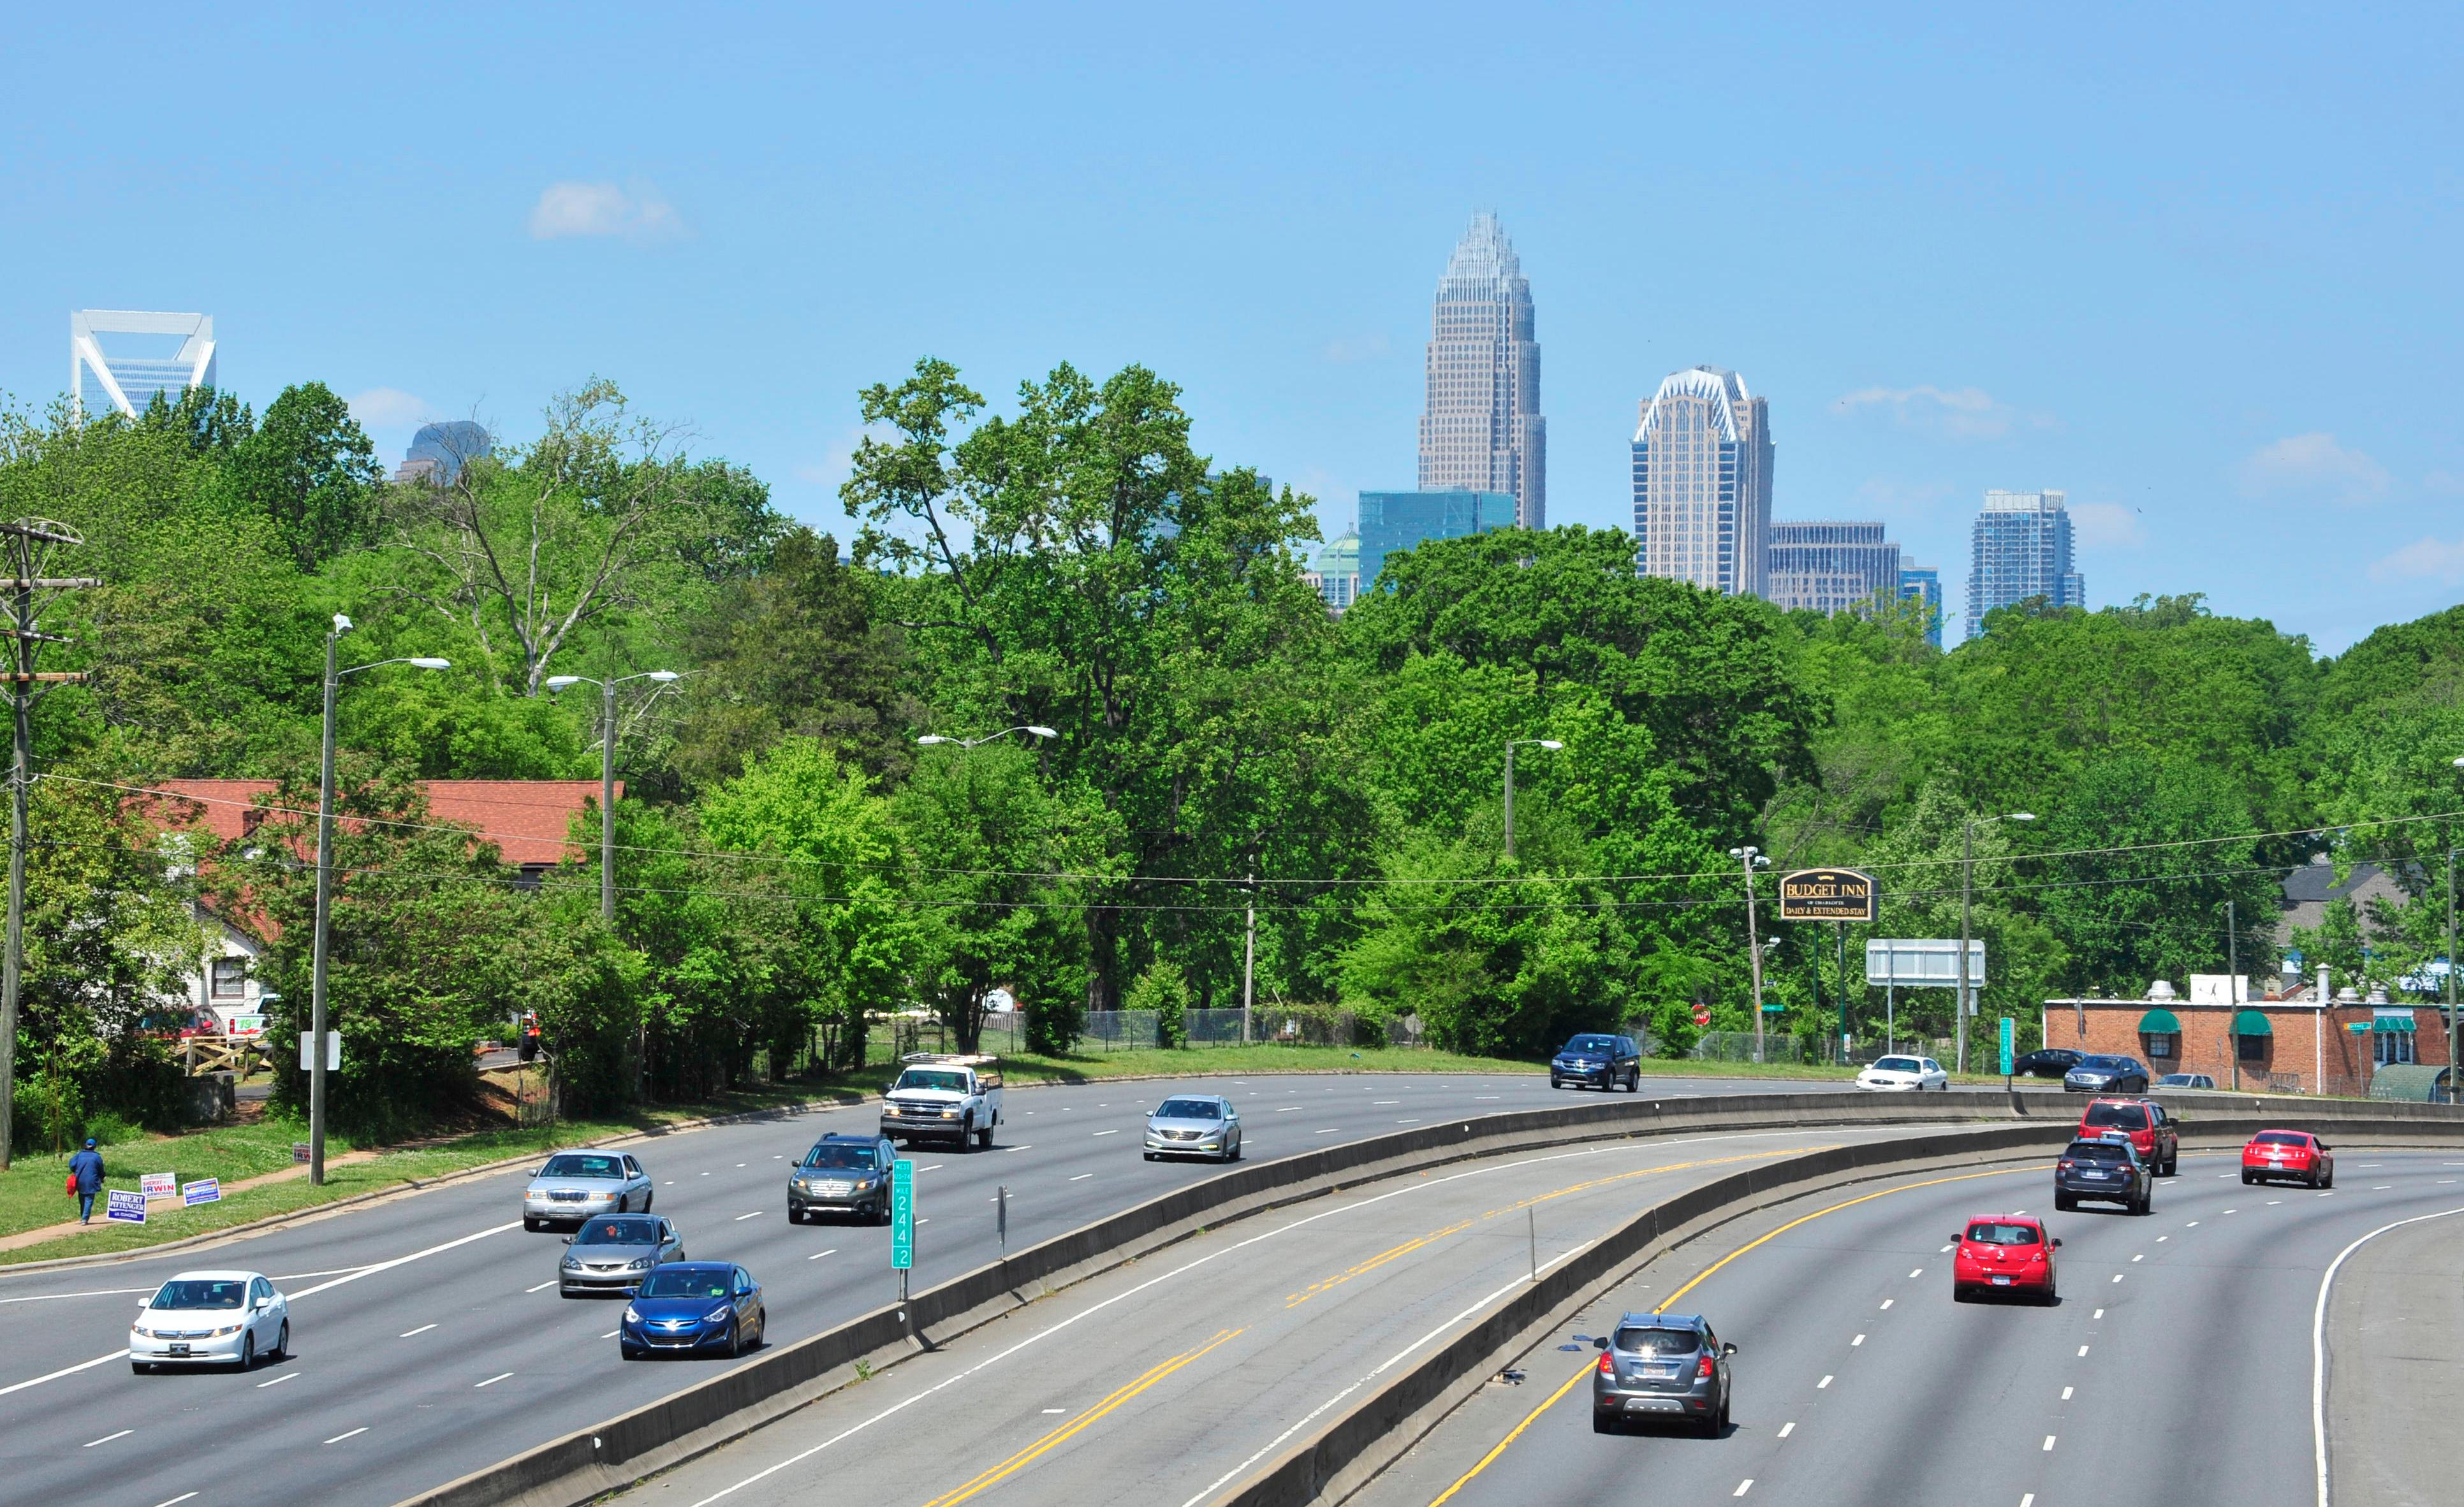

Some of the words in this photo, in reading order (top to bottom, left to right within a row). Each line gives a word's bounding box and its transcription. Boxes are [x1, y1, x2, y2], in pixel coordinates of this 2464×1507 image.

[1786, 884, 1837, 896] BUDGET
[1841, 884, 1866, 896] INN
[143, 1184, 174, 1193] IRWIN
[112, 1193, 143, 1204] ROBERT
